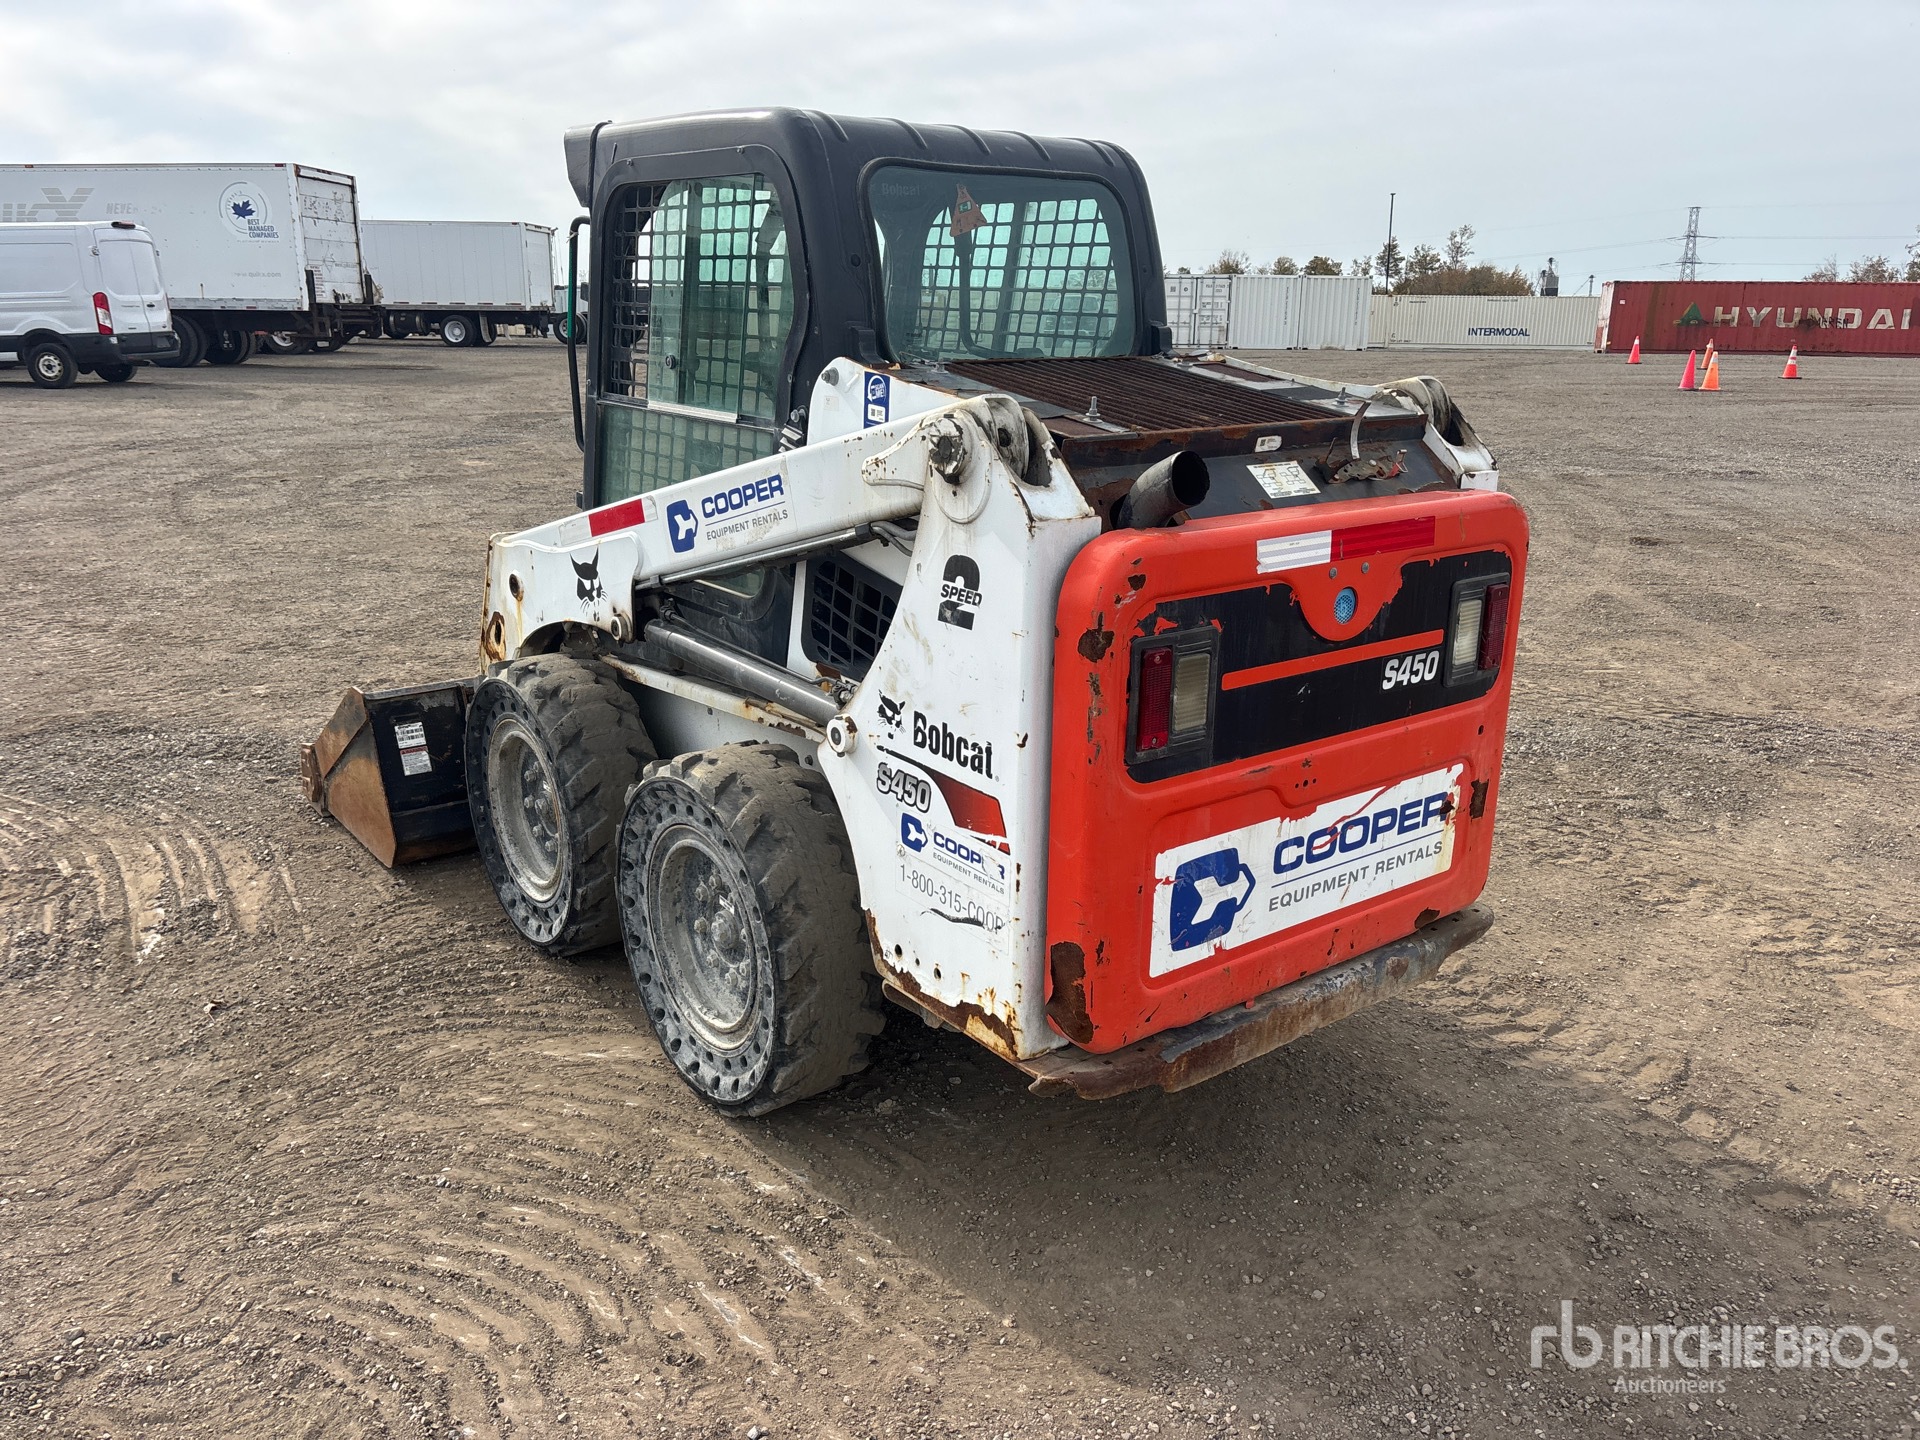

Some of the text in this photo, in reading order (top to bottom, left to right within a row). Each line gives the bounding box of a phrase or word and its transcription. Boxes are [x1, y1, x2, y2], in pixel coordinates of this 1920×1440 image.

[248, 231, 279, 239] COMPANIES
[1467, 327, 1530, 337] INTERMODAL
[1713, 306, 1912, 330] HYUNDAI
[701, 473, 784, 519] COOPER
[706, 509, 789, 541] EQUIPMENT RENTALS
[940, 583, 983, 607] SPEED
[1382, 650, 1440, 690] S450
[913, 710, 993, 780] Bobcat
[876, 761, 932, 813] S450
[1273, 791, 1450, 875] COOPER
[932, 852, 1005, 895] EQUIPMENT RENTALS
[933, 831, 1005, 880] COOPR
[1268, 840, 1444, 913] EQUIPMENT RENTALS
